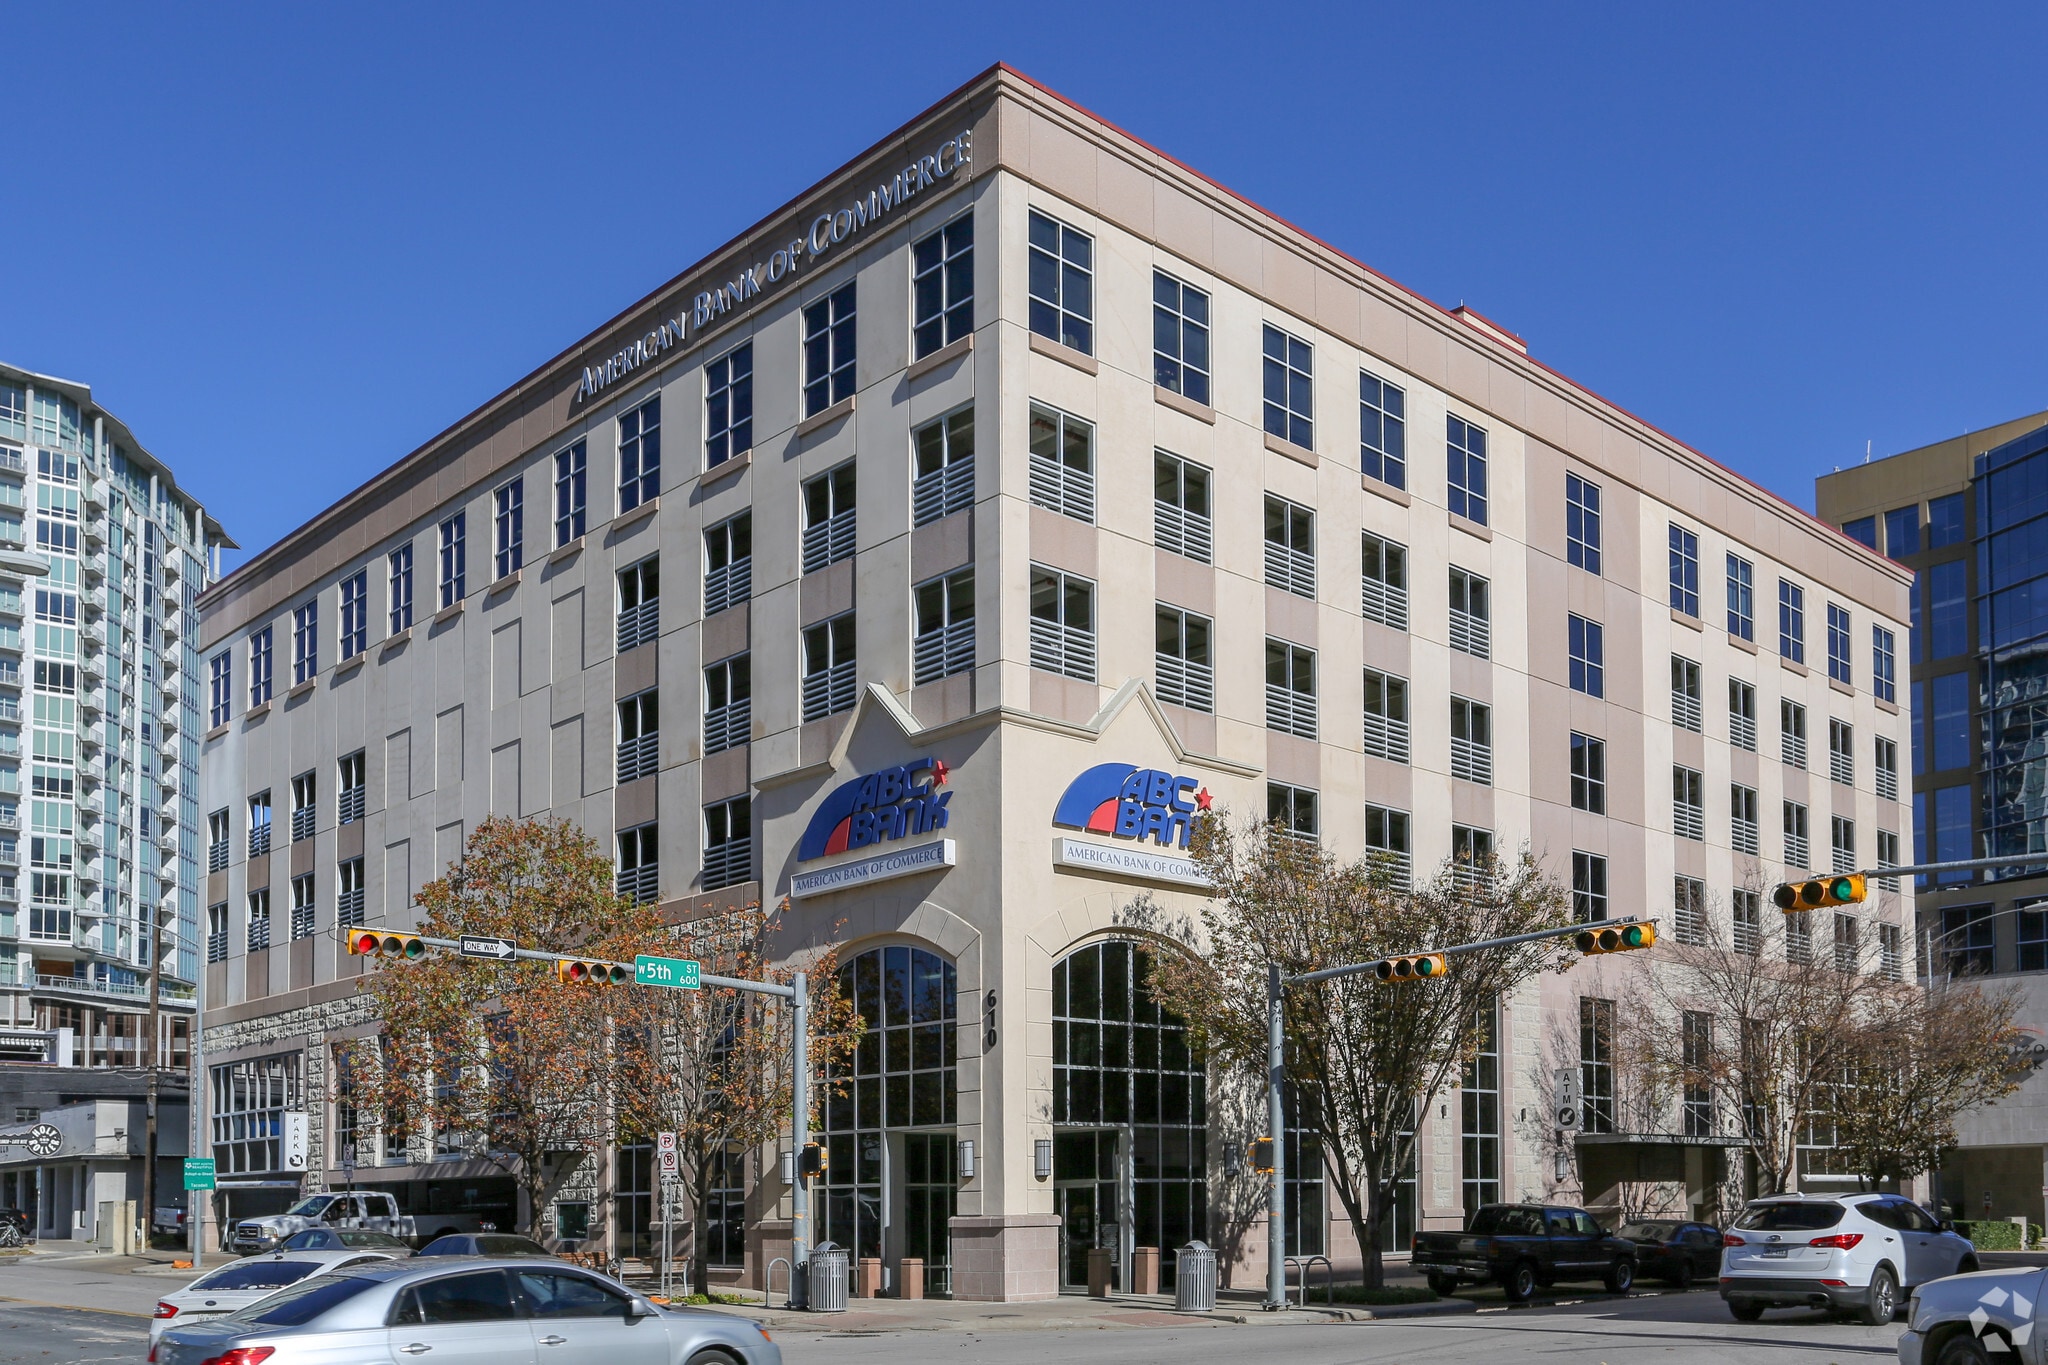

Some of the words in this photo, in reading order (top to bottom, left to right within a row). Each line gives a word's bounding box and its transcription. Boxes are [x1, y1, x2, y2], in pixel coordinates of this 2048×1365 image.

[577, 311, 686, 403] AMERICAN
[693, 262, 762, 330] BANK
[767, 238, 803, 283] OF
[807, 129, 971, 256] COMMERCE
[852, 757, 933, 812] ABC
[1121, 768, 1199, 812] ABC
[847, 791, 954, 850] BANK
[1115, 801, 1208, 849] BAN
[795, 871, 842, 892] AMERICAN
[844, 865, 869, 880] BANK
[870, 861, 884, 874] OF
[886, 847, 942, 871] COMMERCE
[1067, 846, 1121, 866] AMERICAN
[1124, 857, 1151, 870] BANK
[1153, 861, 1167, 872] OF
[466, 941, 481, 951] ONE
[484, 943, 499, 952] WAY
[638, 965, 645, 974] W
[647, 963, 672, 980] 5th
[686, 965, 697, 974] ST
[680, 976, 697, 985] 600
[987, 989, 997, 1047] 610
[1563, 1072, 1571, 1104] ATM
[28, 1139, 60, 1155] ROLLER
[31, 1125, 58, 1138] HOLY
